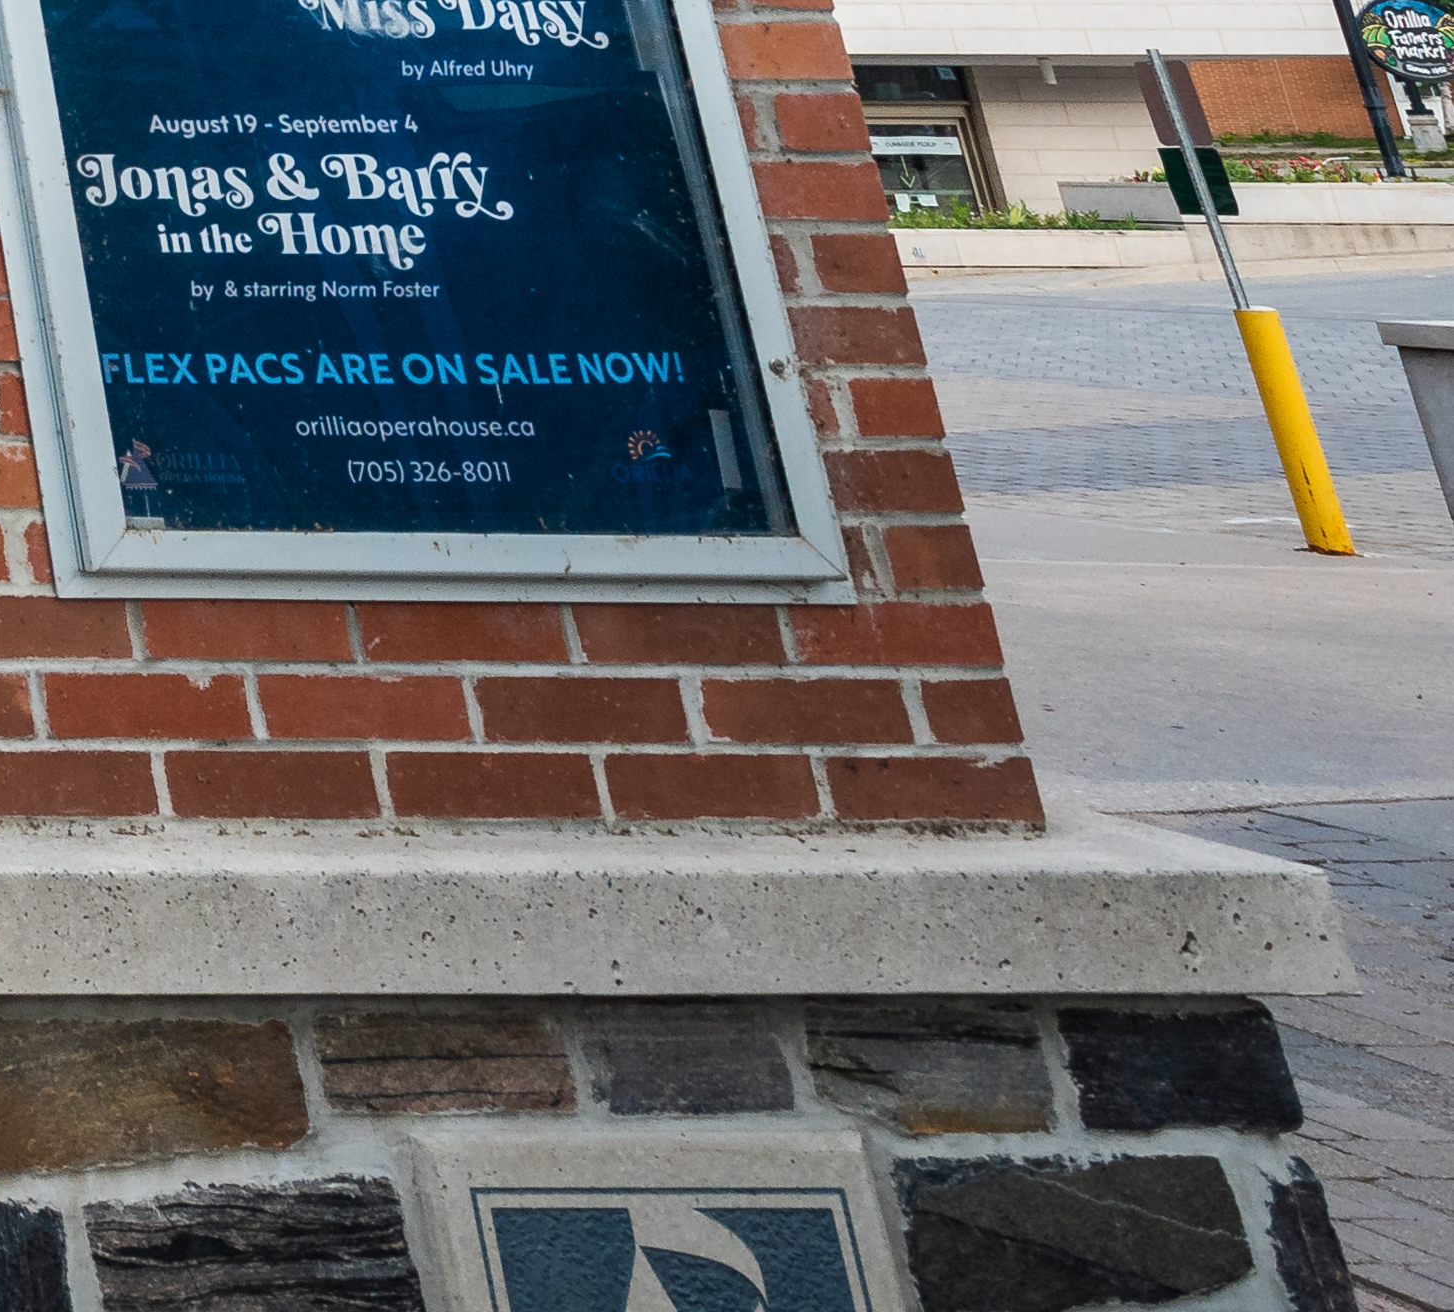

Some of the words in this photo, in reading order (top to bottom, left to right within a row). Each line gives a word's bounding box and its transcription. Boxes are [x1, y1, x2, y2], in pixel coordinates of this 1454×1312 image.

[1384, 10, 1432, 28] Orillia
[149, 114, 229, 138] August
[234, 114, 258, 134] 19
[278, 114, 400, 138] September
[404, 114, 418, 134] 4
[76, 152, 255, 217] Jonas
[320, 151, 514, 220] Barry
[158, 225, 194, 255] in
[200, 222, 253, 255] the
[257, 212, 426, 270] Home
[102, 353, 198, 385] FLEX
[206, 352, 303, 385] PACS
[317, 353, 394, 385] ARE
[402, 352, 464, 385] ON
[475, 352, 572, 385] SALE
[579, 351, 683, 383] NOW!
[295, 415, 535, 442] orilliaoperahouse.ca
[347, 459, 406, 485] (705)
[412, 459, 511, 483] 326-8011
